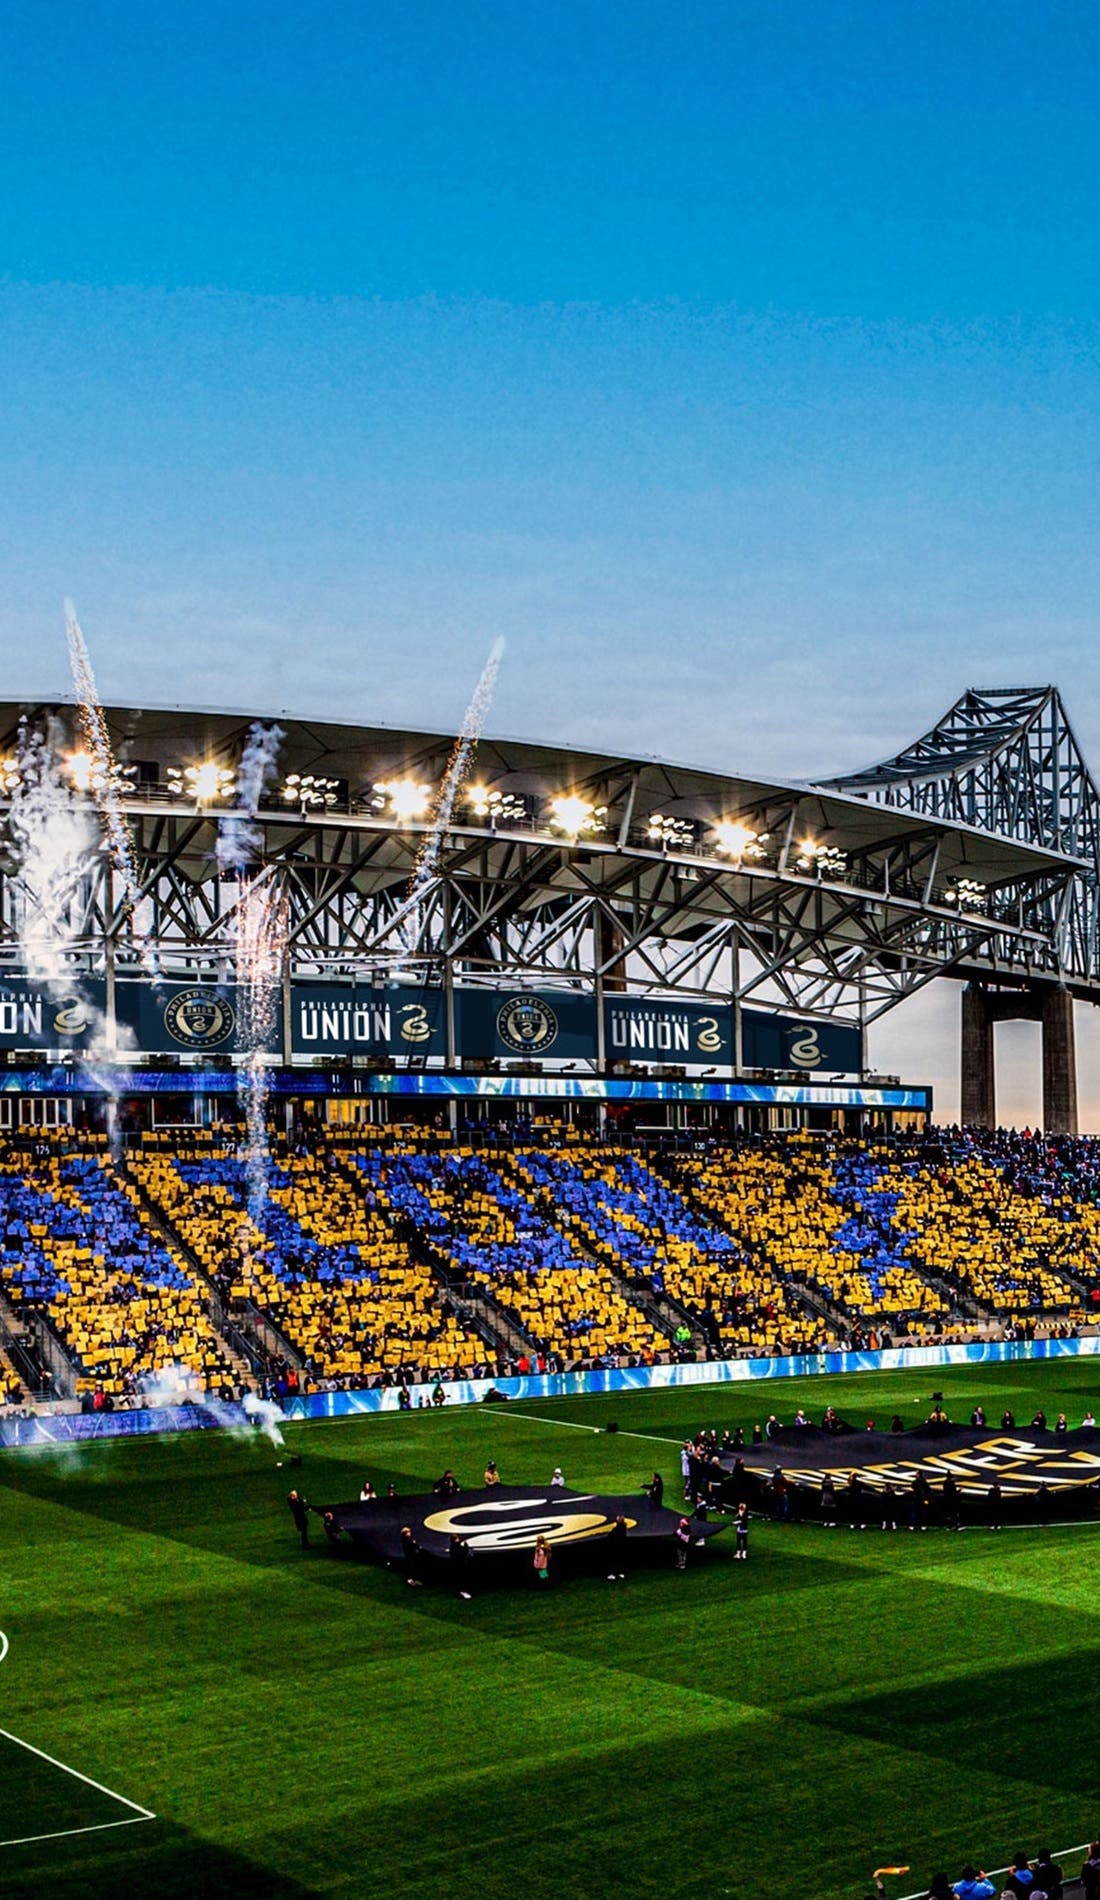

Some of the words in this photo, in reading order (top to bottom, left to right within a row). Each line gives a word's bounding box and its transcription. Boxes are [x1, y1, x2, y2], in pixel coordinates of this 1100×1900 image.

[300, 1001, 391, 1011] PHILADELPHIA
[611, 1010, 688, 1023] PHILADELPHIA
[300, 1009, 391, 1041] UNION
[611, 1018, 689, 1051] UNION
